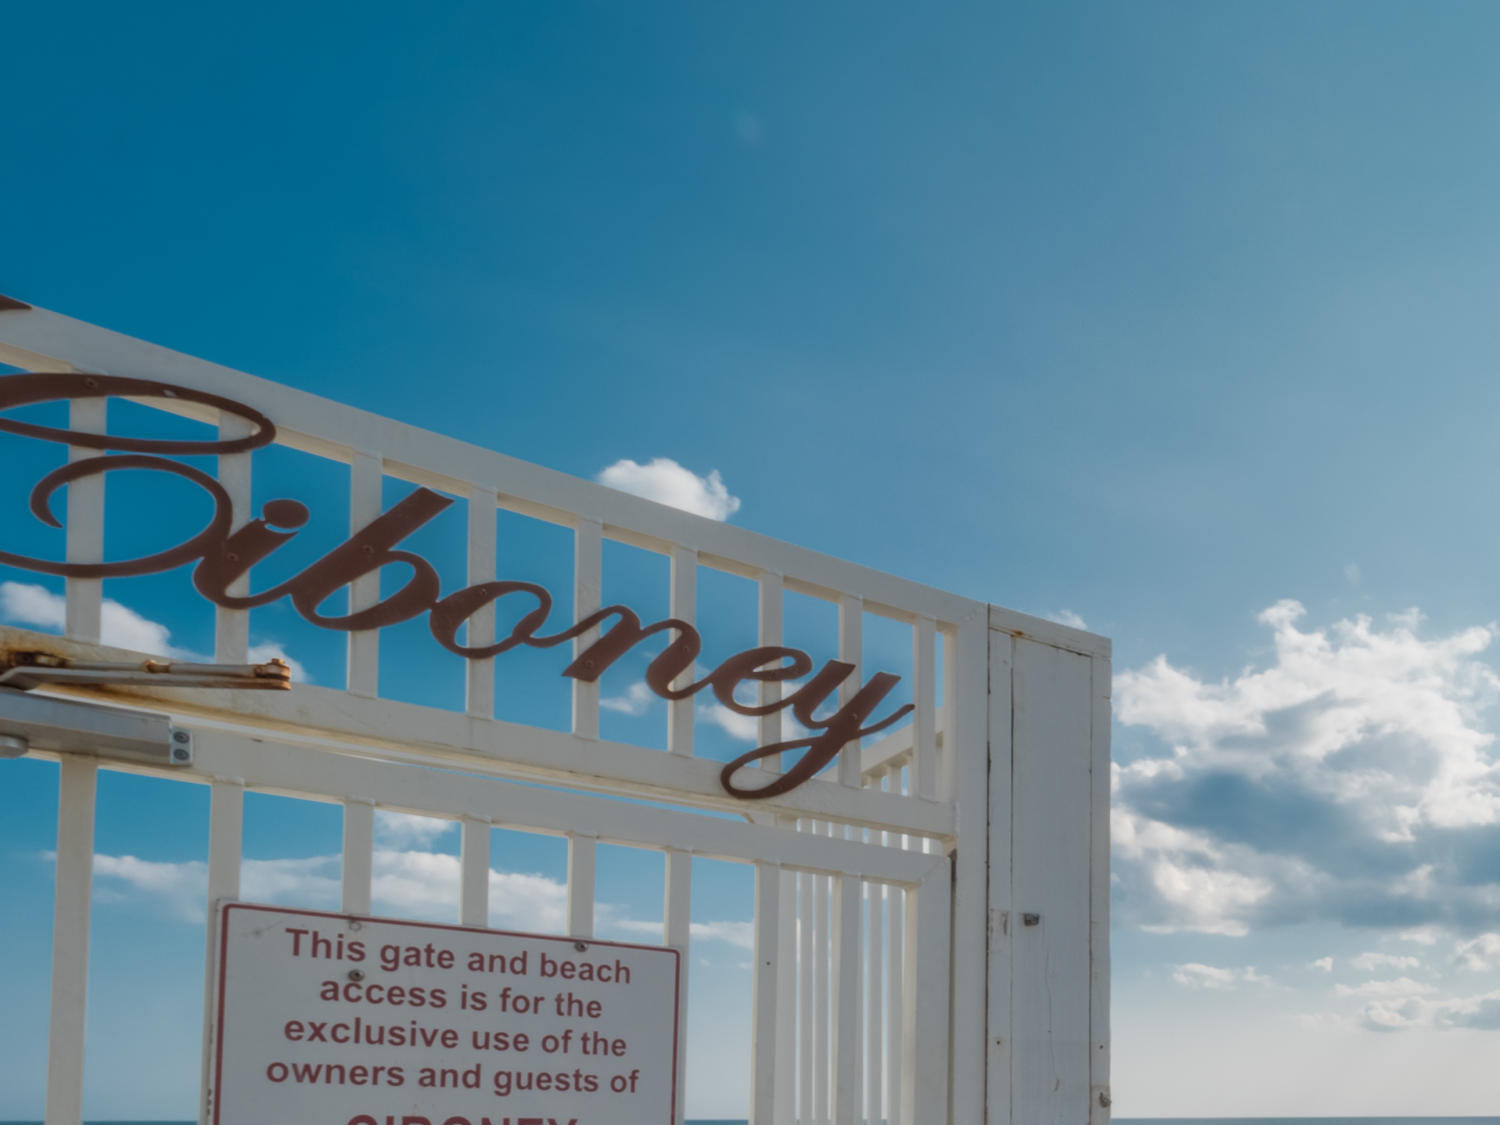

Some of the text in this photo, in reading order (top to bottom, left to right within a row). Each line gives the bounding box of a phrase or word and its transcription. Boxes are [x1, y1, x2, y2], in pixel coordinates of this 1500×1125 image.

[285, 927, 633, 985] This gate and beach
[319, 979, 602, 1019] access is for the
[284, 1017, 627, 1057] exclusive use of the
[266, 1062, 640, 1097] owners and guests of
